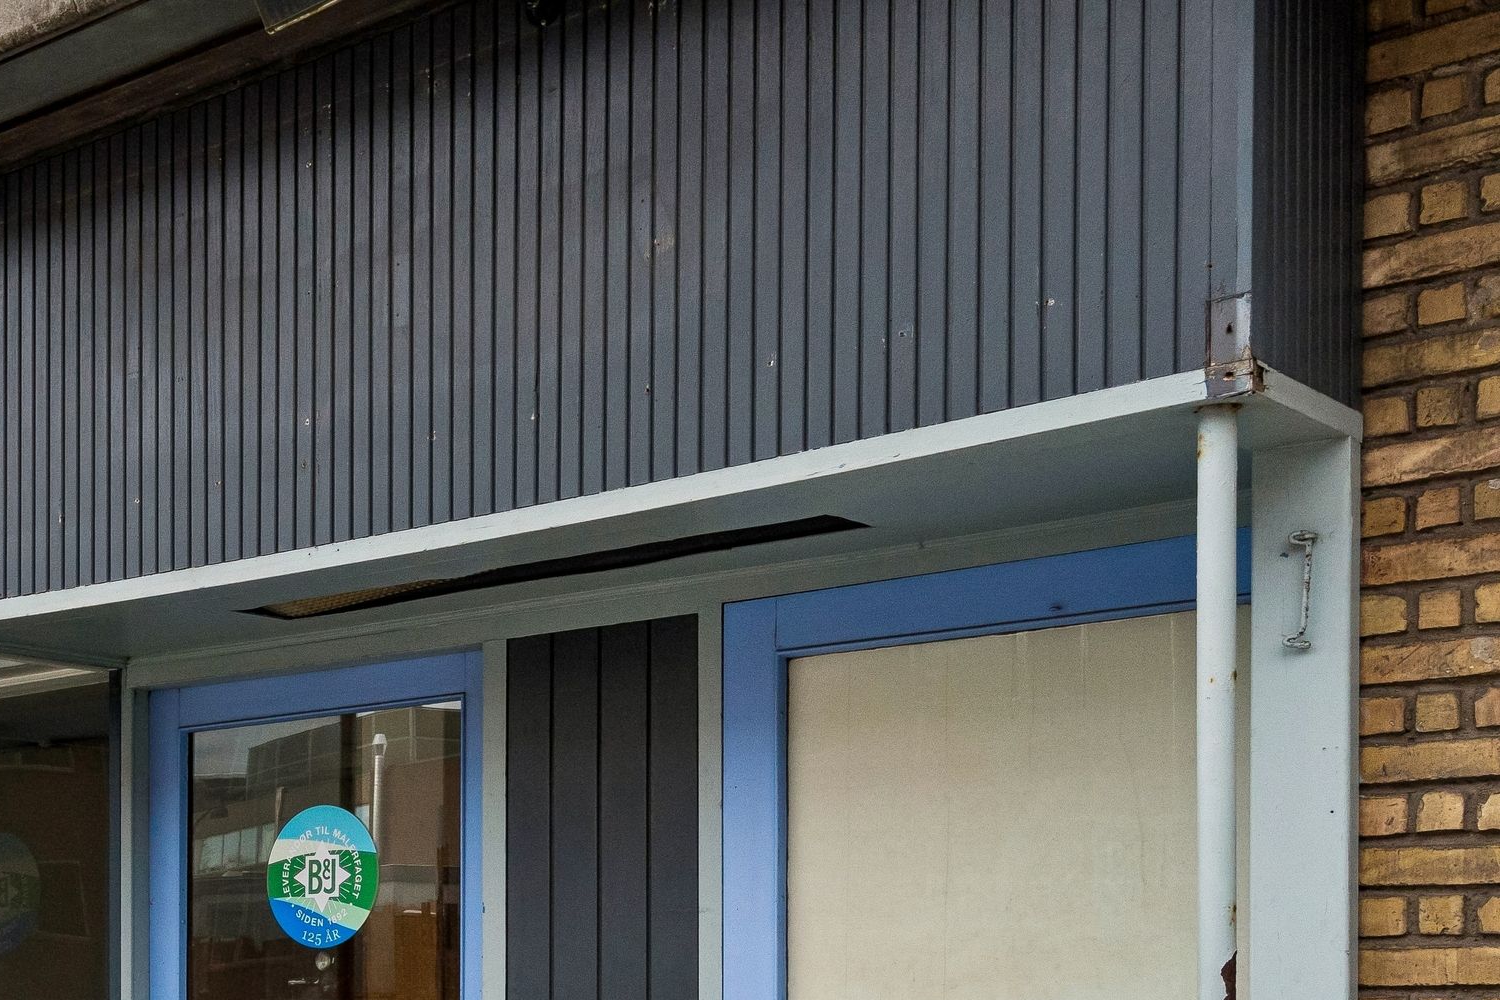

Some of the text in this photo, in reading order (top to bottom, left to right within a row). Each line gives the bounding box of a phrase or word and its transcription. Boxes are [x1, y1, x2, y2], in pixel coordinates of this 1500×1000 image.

[315, 825, 330, 836] TIL
[308, 858, 336, 895] B&J
[295, 908, 349, 927] SIDEN 1892
[302, 928, 341, 946] 125 ÅR
